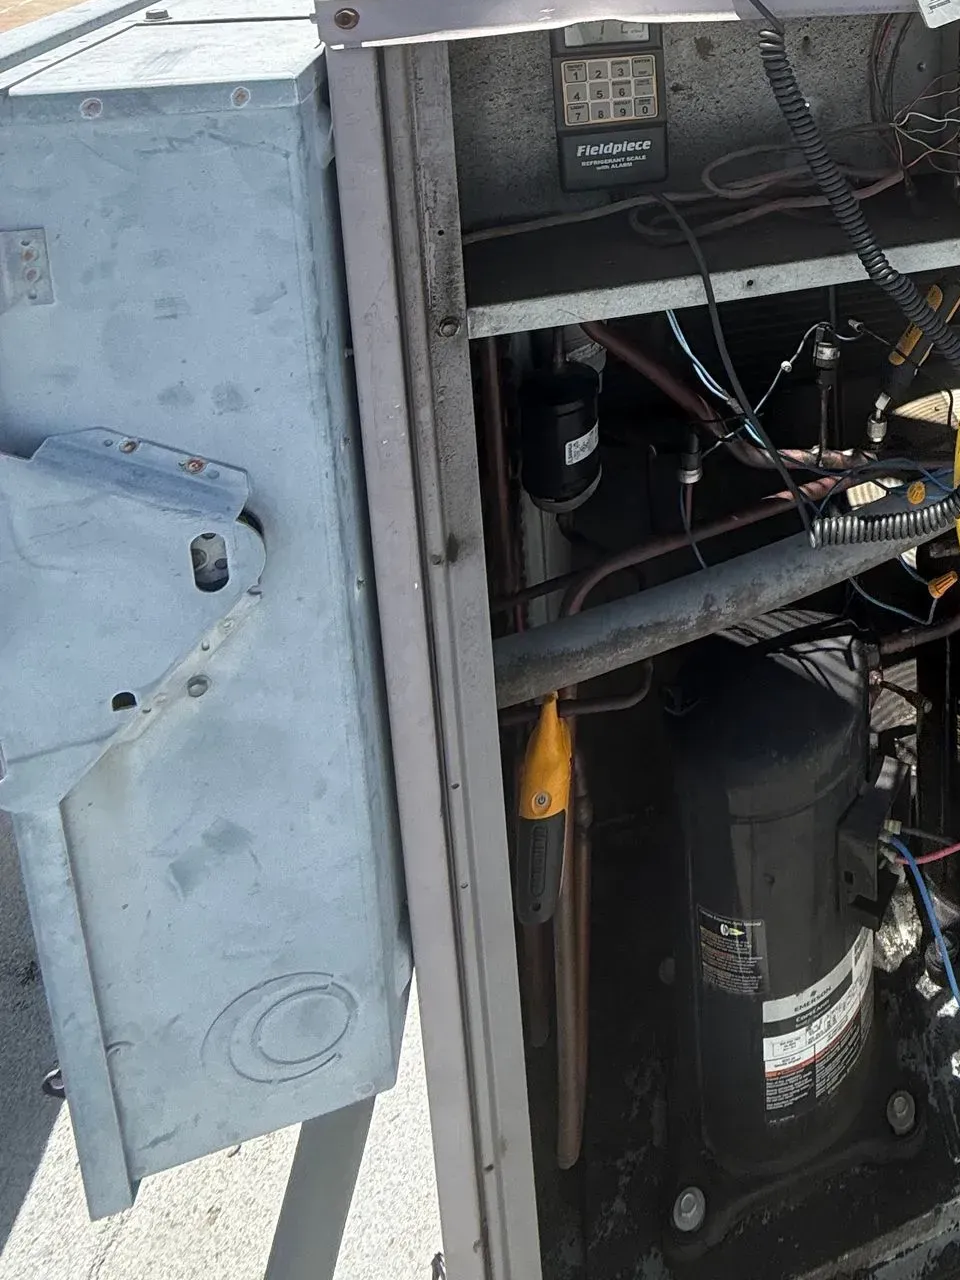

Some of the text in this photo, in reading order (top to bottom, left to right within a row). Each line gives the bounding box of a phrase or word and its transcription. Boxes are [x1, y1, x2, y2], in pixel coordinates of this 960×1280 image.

[595, 70, 602, 79] 2
[618, 68, 624, 77] 3
[574, 92, 580, 101] 4
[596, 90, 603, 98] 5
[619, 88, 625, 96] 6
[598, 110, 604, 119] 8
[620, 108, 626, 116] 9
[642, 106, 648, 114] 0
[575, 112, 581, 120] 7
[576, 140, 651, 157] Fieldpiece
[582, 157, 625, 166] REFRIGERANT
[794, 985, 832, 1012] EMERSON
